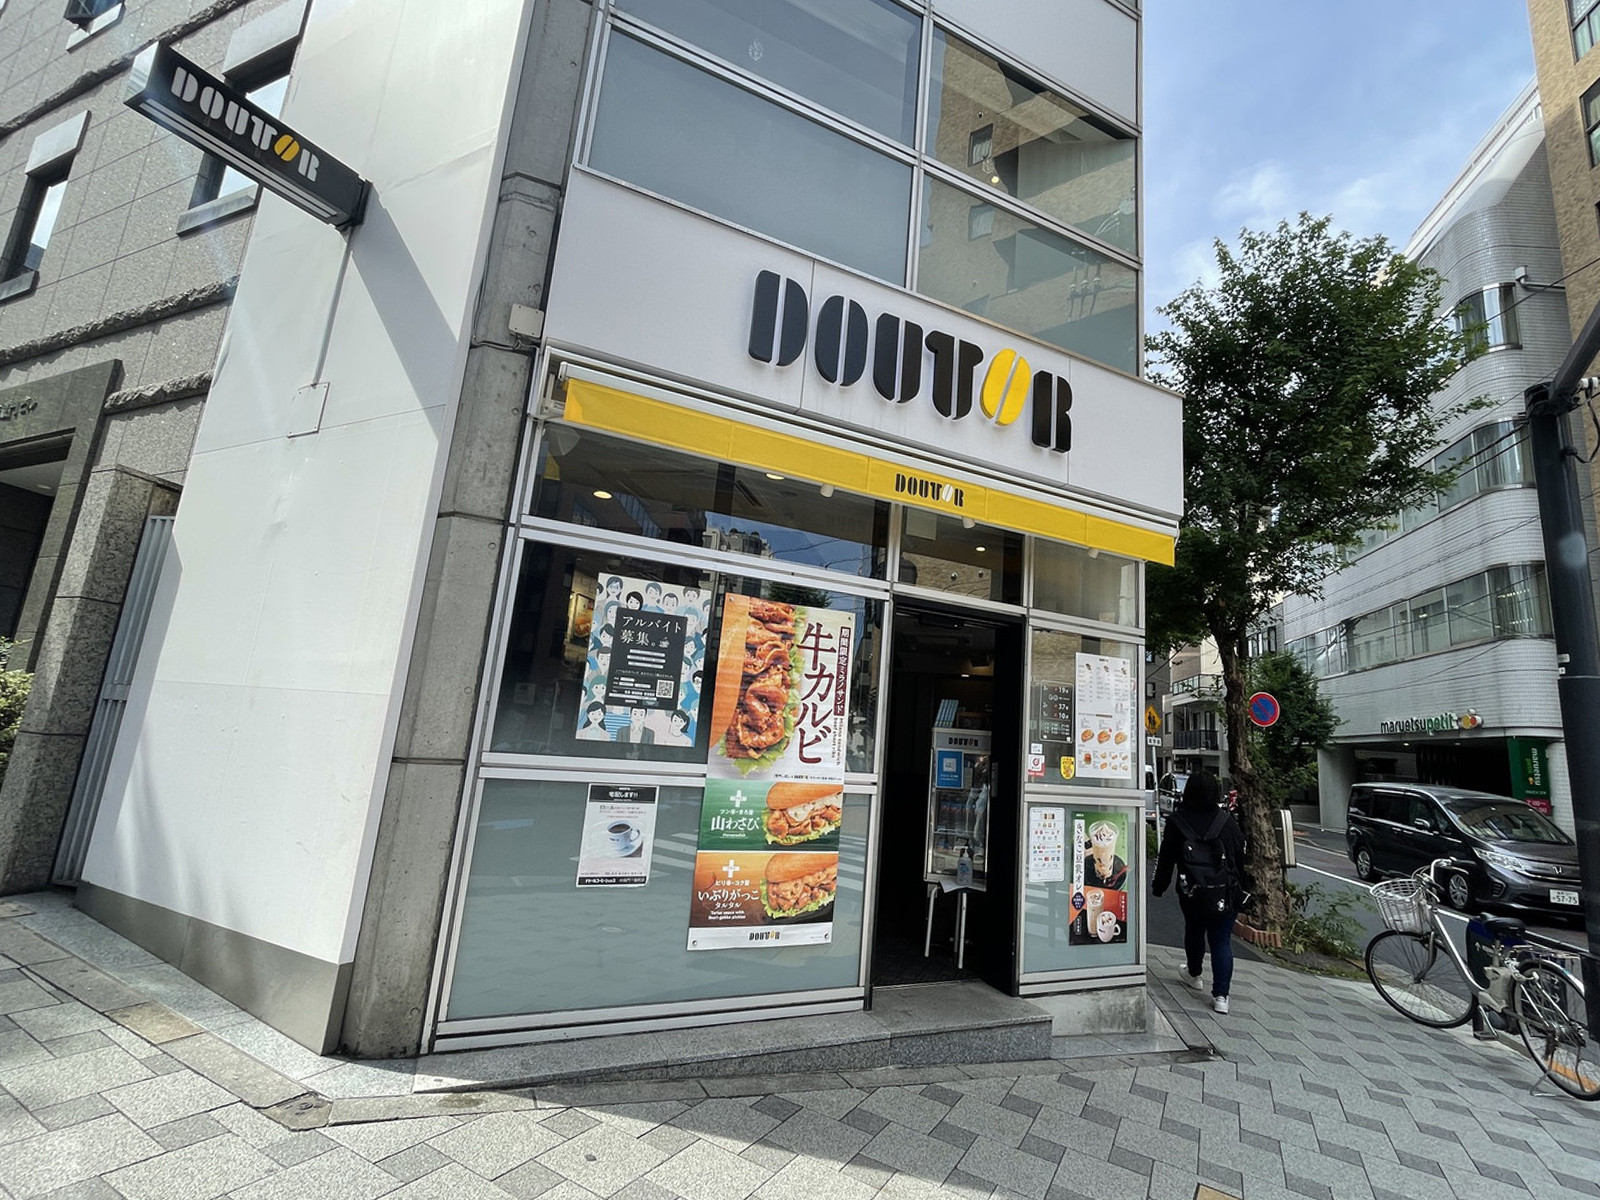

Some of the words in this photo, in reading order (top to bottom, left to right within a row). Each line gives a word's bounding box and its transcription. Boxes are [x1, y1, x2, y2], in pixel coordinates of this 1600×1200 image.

[170, 66, 320, 182] DOUTOR
[748, 269, 1073, 453] DOUTOR
[895, 473, 964, 507] DOUTOR
[622, 616, 682, 634] アルバイト
[620, 629, 656, 647] 募集。
[795, 622, 837, 764] 牛カルビ
[710, 815, 760, 831] 山わさび
[698, 888, 760, 902] いぶりがっこ
[714, 901, 742, 910] タルタル
[749, 931, 780, 941] DOUTOR
